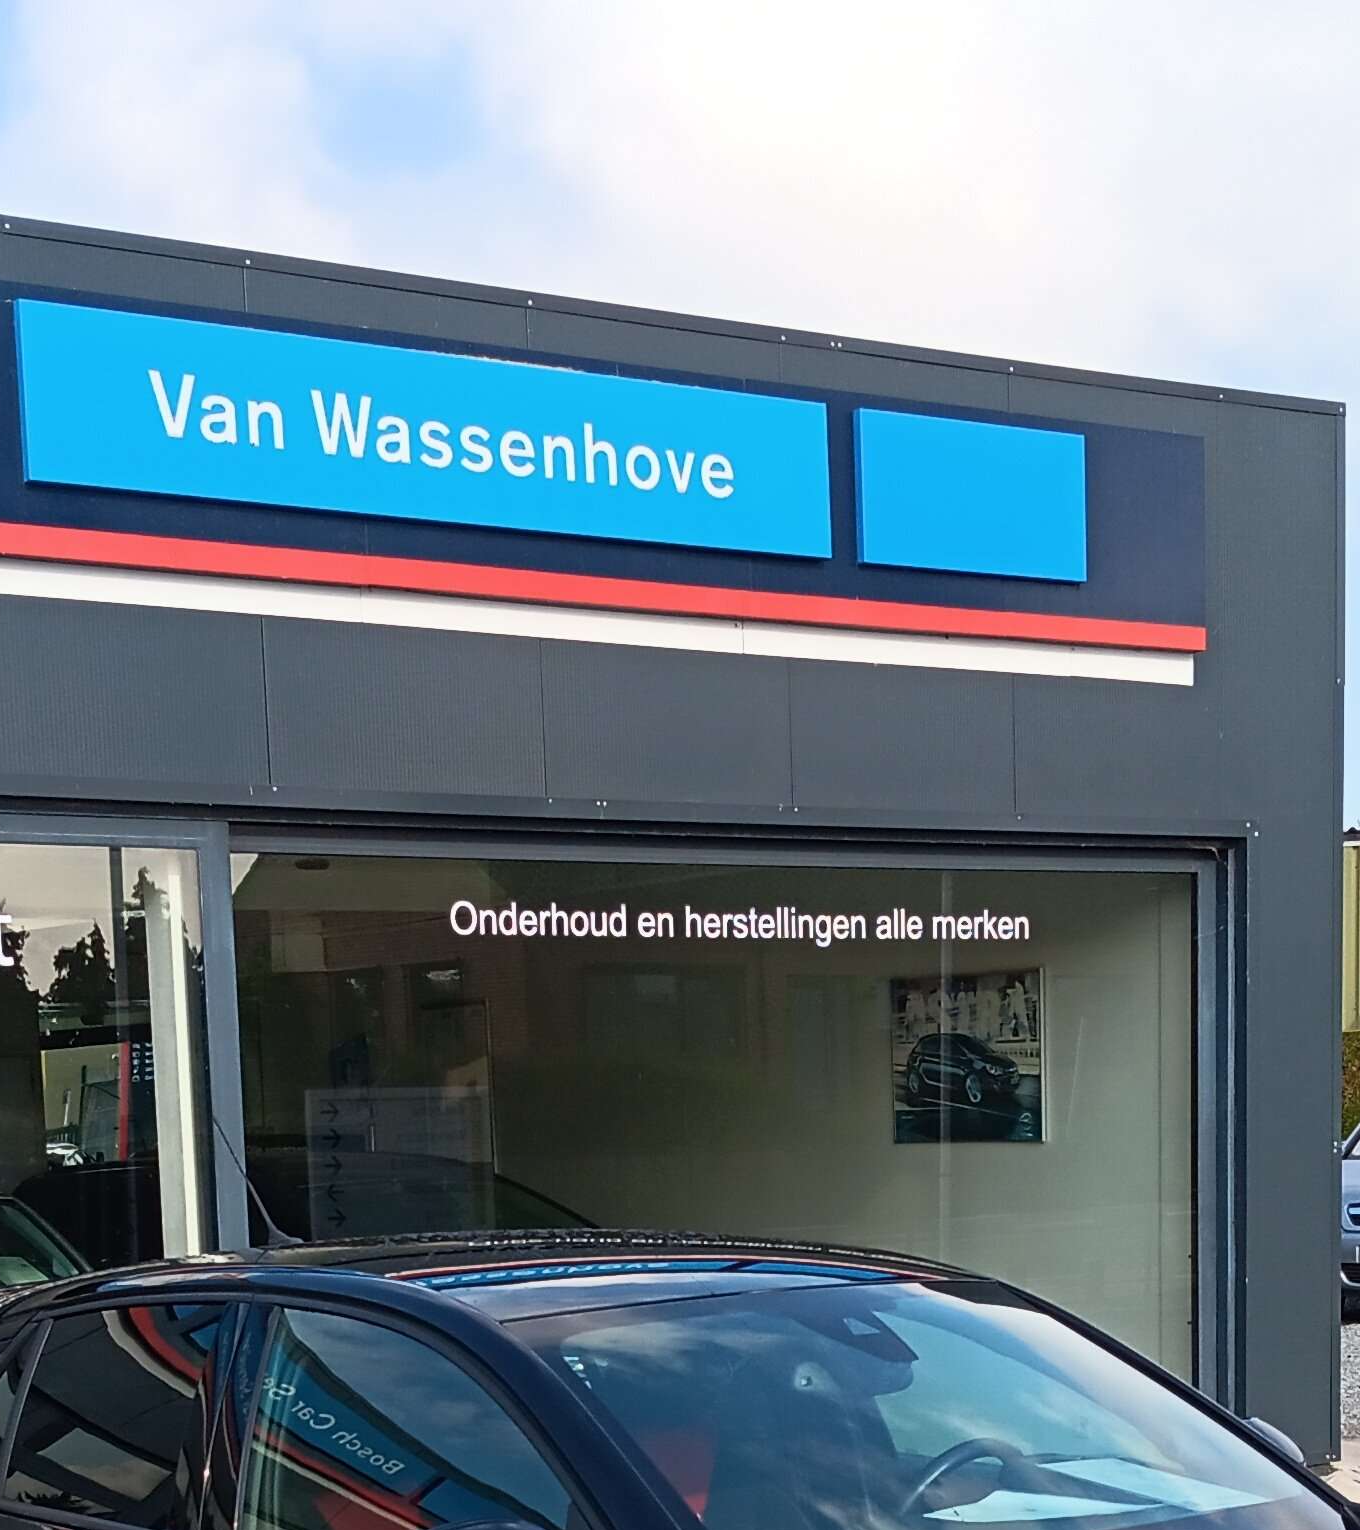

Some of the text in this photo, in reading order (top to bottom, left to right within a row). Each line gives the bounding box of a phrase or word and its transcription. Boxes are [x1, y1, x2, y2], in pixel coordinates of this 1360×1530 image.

[148, 369, 734, 499] Van Wassenhove
[449, 900, 1030, 948] Onderhoud en herstellingen alle merken
